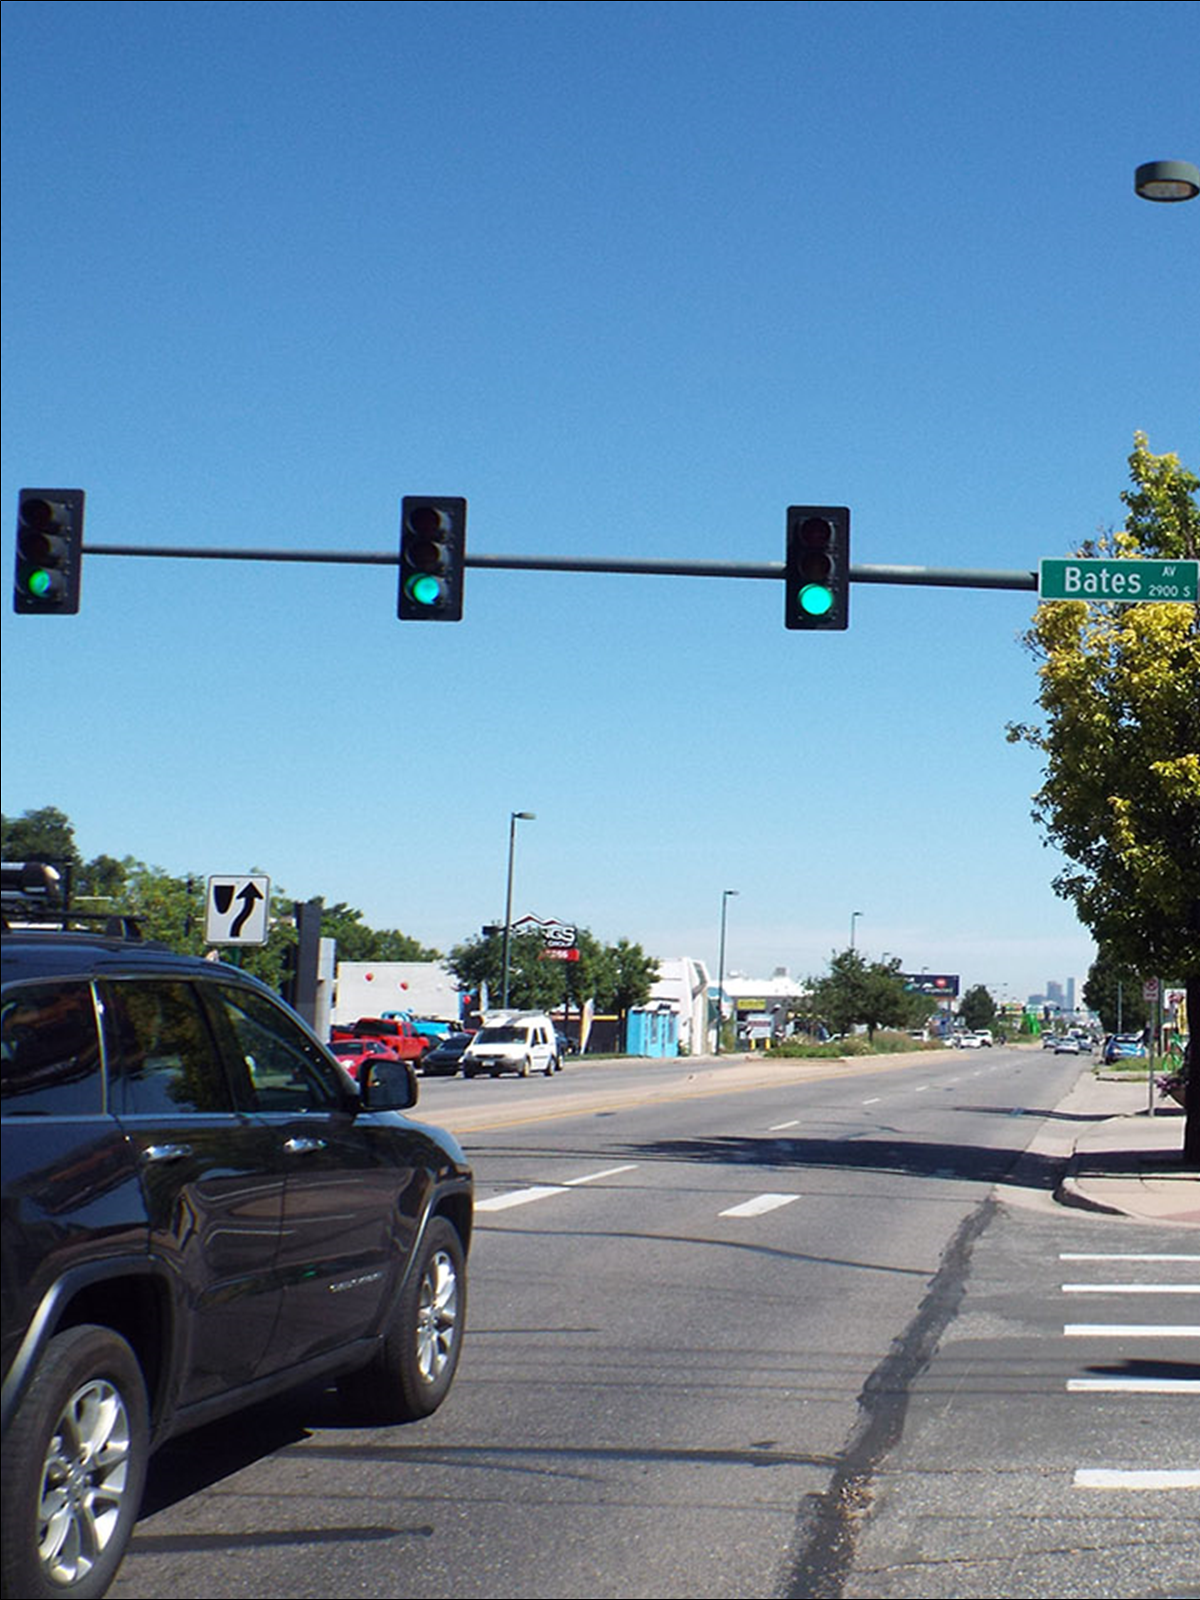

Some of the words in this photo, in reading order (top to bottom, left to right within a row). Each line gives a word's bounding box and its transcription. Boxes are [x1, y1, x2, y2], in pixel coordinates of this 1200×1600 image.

[1064, 566, 1142, 594] Bates
[1162, 565, 1177, 578] AV
[1148, 584, 1179, 597] 2900
[1183, 585, 1191, 598] S
